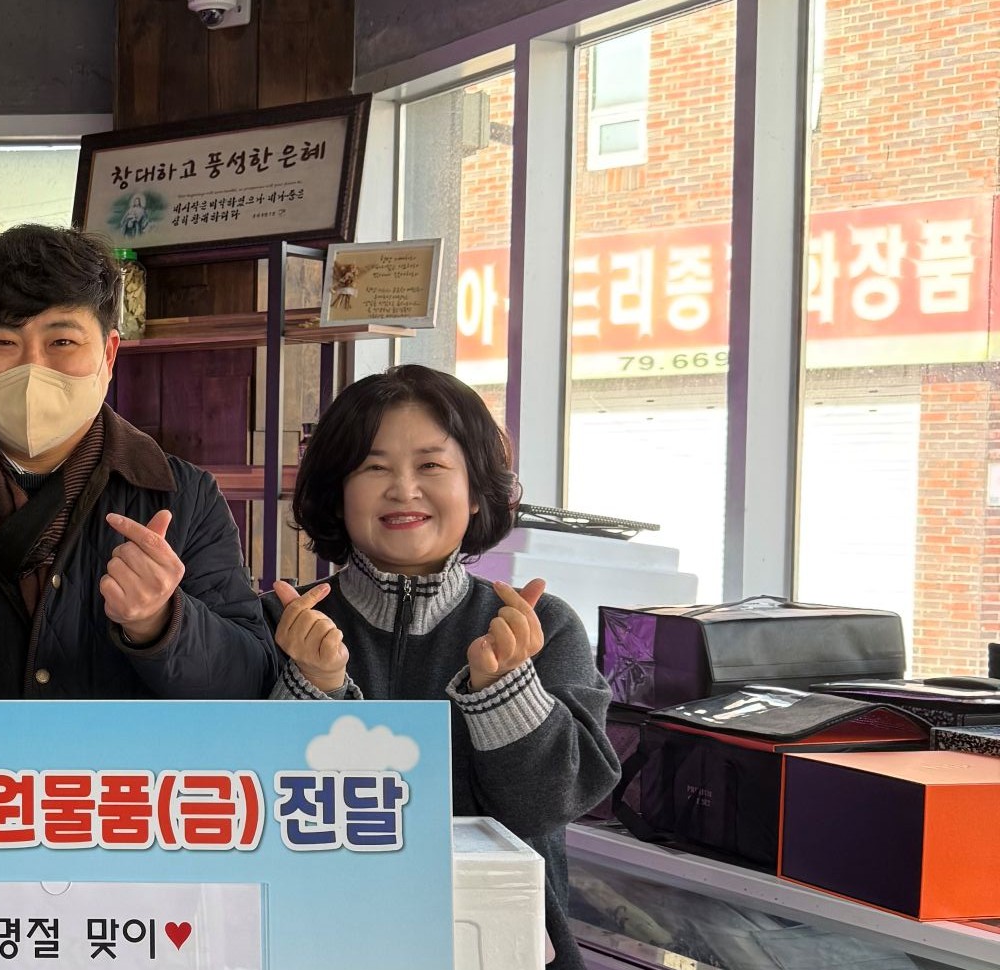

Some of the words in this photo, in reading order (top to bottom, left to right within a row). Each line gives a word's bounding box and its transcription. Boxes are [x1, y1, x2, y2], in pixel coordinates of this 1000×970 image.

[111, 159, 197, 190] 창대하고
[204, 146, 274, 179] 풍성한
[277, 140, 327, 169] 은혜
[277, 771, 406, 850] 전달
[86, 917, 158, 960] 맞이
